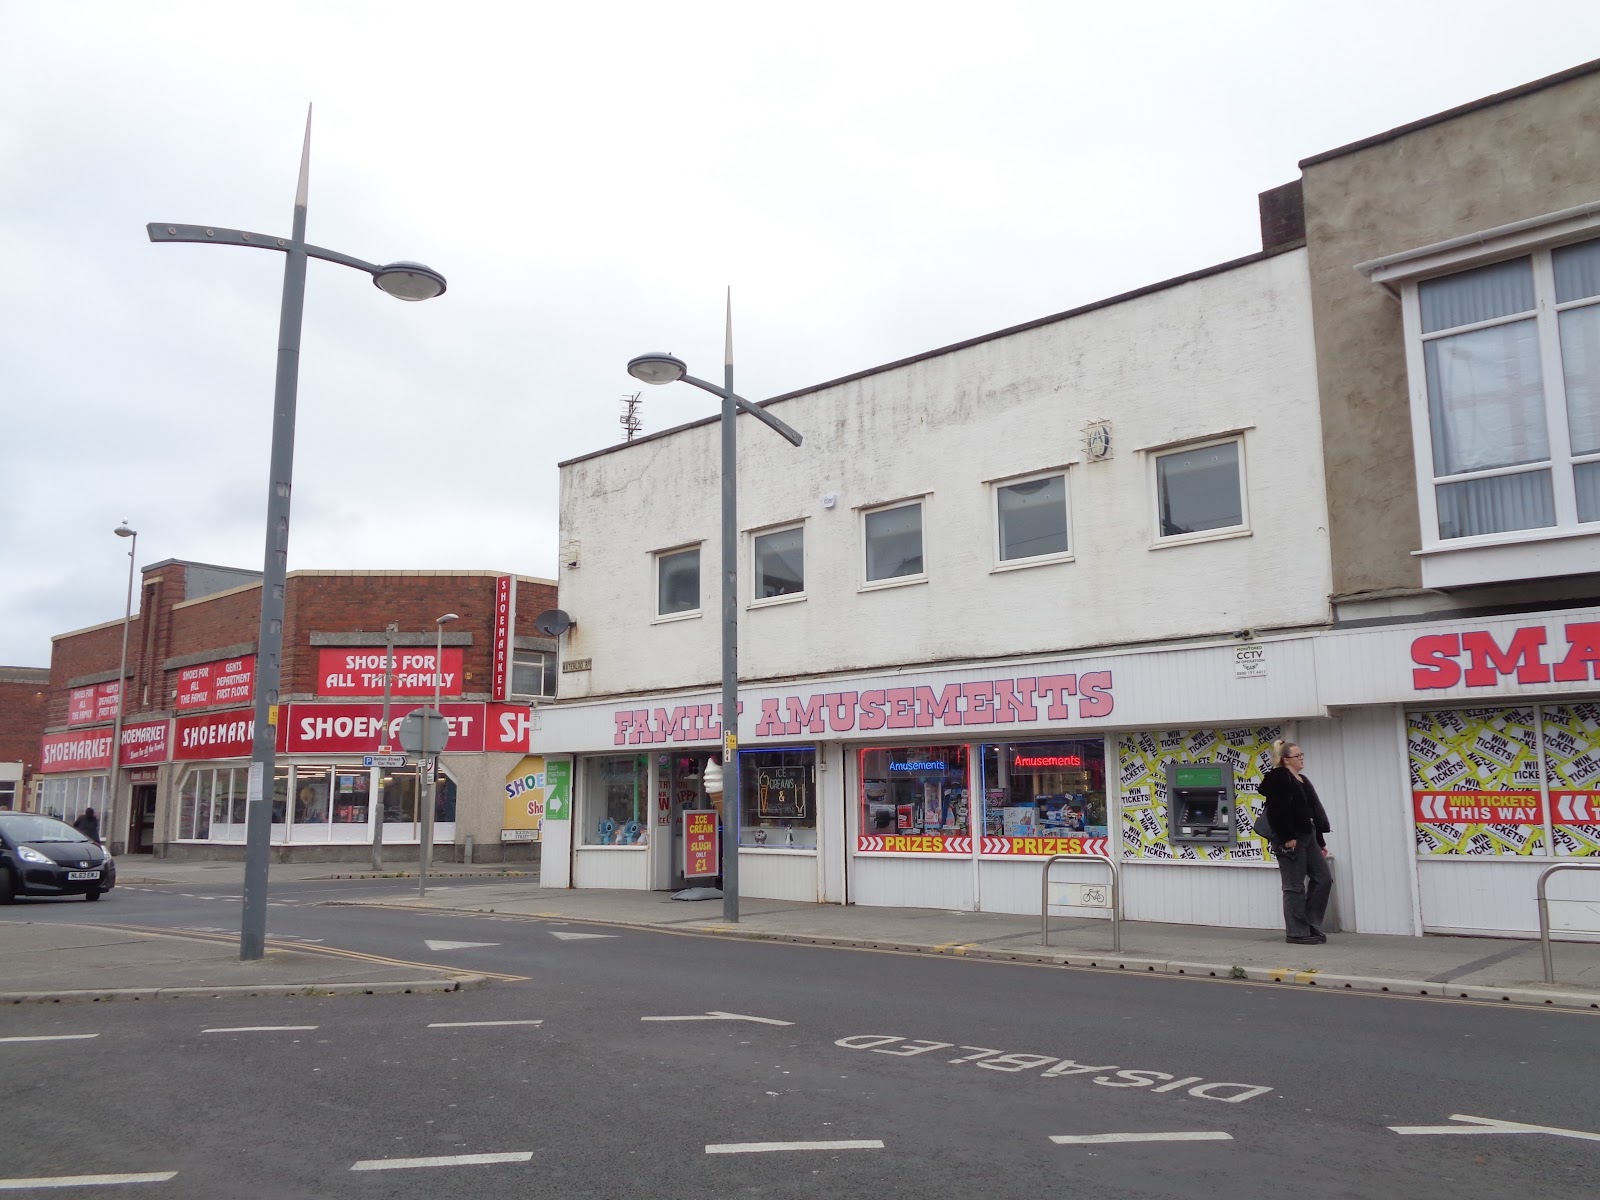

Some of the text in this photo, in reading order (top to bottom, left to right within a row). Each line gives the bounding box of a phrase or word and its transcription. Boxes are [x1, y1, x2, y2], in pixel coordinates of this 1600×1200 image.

[496, 580, 507, 696] SHOEMARKET
[1236, 650, 1262, 660] CCTV
[226, 662, 242, 672] GENTS
[346, 655, 436, 670] SHOES FOR
[182, 668, 208, 680] SHOES FOR
[216, 672, 250, 686] DEPARTMENT
[190, 682, 199, 691] ALL
[326, 674, 355, 688] ALL
[180, 692, 208, 704] THE FAMILY
[216, 686, 248, 700] FIRST FLOOR
[756, 670, 1114, 736] AMUSEMENTS
[1503, 709, 1521, 723] WIN
[1573, 705, 1588, 722] WIN
[1434, 712, 1450, 729] WIN
[1188, 732, 1216, 754] TICKETS!
[1191, 731, 1205, 742] WIN
[1230, 738, 1245, 746] WIN
[1491, 734, 1509, 748] WIN
[1557, 731, 1577, 746] WIN
[1420, 737, 1438, 750] WIN
[1476, 737, 1515, 762] TICKETS!
[44, 738, 112, 764] SHOEMARKET
[1227, 748, 1240, 759] WIN
[889, 760, 945, 771] Amusements
[1015, 755, 1080, 766] Amusements
[1123, 761, 1136, 773] WIN
[1434, 758, 1451, 772] WIN
[1572, 754, 1593, 769] WIN
[776, 769, 786, 778] ICE
[1121, 763, 1147, 784] TICKETS!
[1430, 760, 1466, 785] TICKETS!
[778, 790, 784, 802] &
[1122, 794, 1150, 804] TICKETS!
[1450, 795, 1536, 806] WIN TICKETS
[695, 815, 708, 824] ICE
[1450, 807, 1537, 820] THIS WAY
[690, 824, 713, 834] CREAM
[1129, 826, 1141, 837] WIN
[1140, 818, 1150, 832] WIN
[691, 841, 712, 851] SLUSH
[885, 836, 944, 852] PRIZES
[1012, 838, 1082, 854] PRIZES
[1237, 841, 1252, 849] WIN
[1470, 833, 1489, 846] WIN
[1144, 846, 1173, 858] TICKETS!
[1230, 848, 1262, 859] TICKETS!
[696, 859, 707, 872] £1
[834, 1034, 1274, 1103] DISABLED
